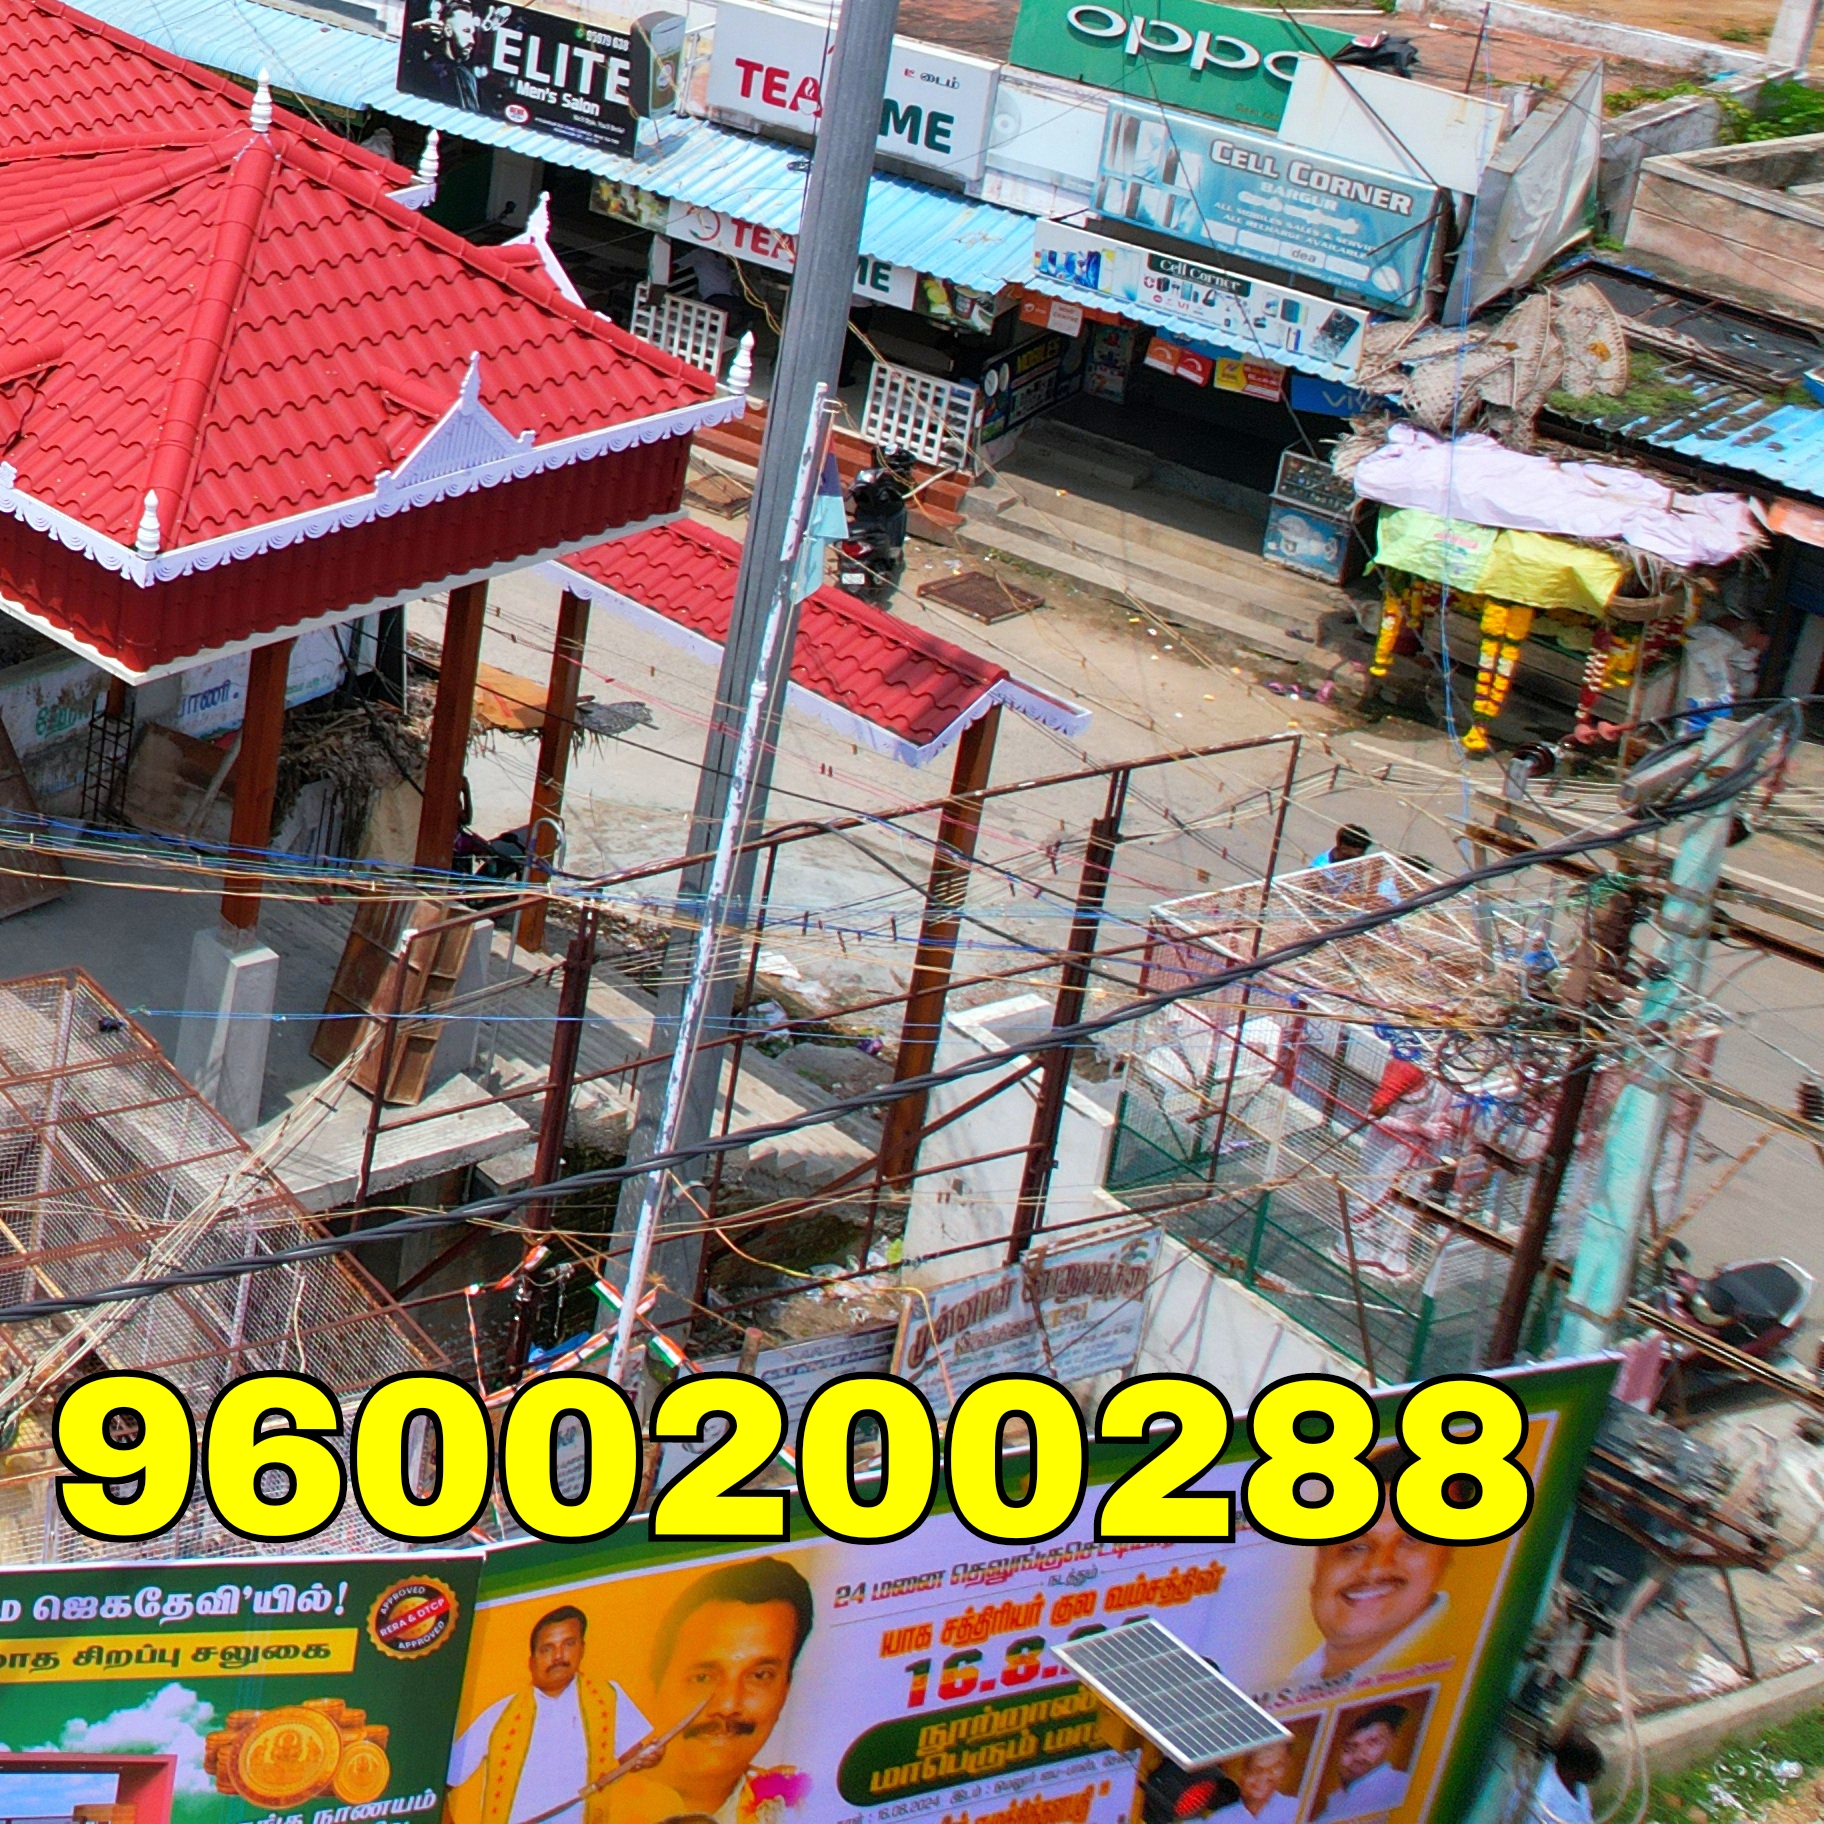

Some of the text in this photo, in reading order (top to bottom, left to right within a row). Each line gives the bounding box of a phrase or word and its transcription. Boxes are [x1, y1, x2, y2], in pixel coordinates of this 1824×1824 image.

[492, 27, 631, 106] ELITE
[516, 80, 600, 116] Men's Salon
[735, 57, 954, 155] TEA ME
[1160, 259, 1186, 276] Cell
[1190, 266, 1242, 291] Corner
[380, 1585, 426, 1615] APPROVED
[833, 1581, 865, 1609] 24
[380, 1597, 445, 1637] RERA & DTCP
[879, 1622, 933, 1658] யாக
[1050, 1590, 1097, 1626] குல
[398, 1621, 445, 1650] APPROVED
[72, 1643, 180, 1672] சிறப்பு
[191, 1642, 331, 1668] சலுகை
